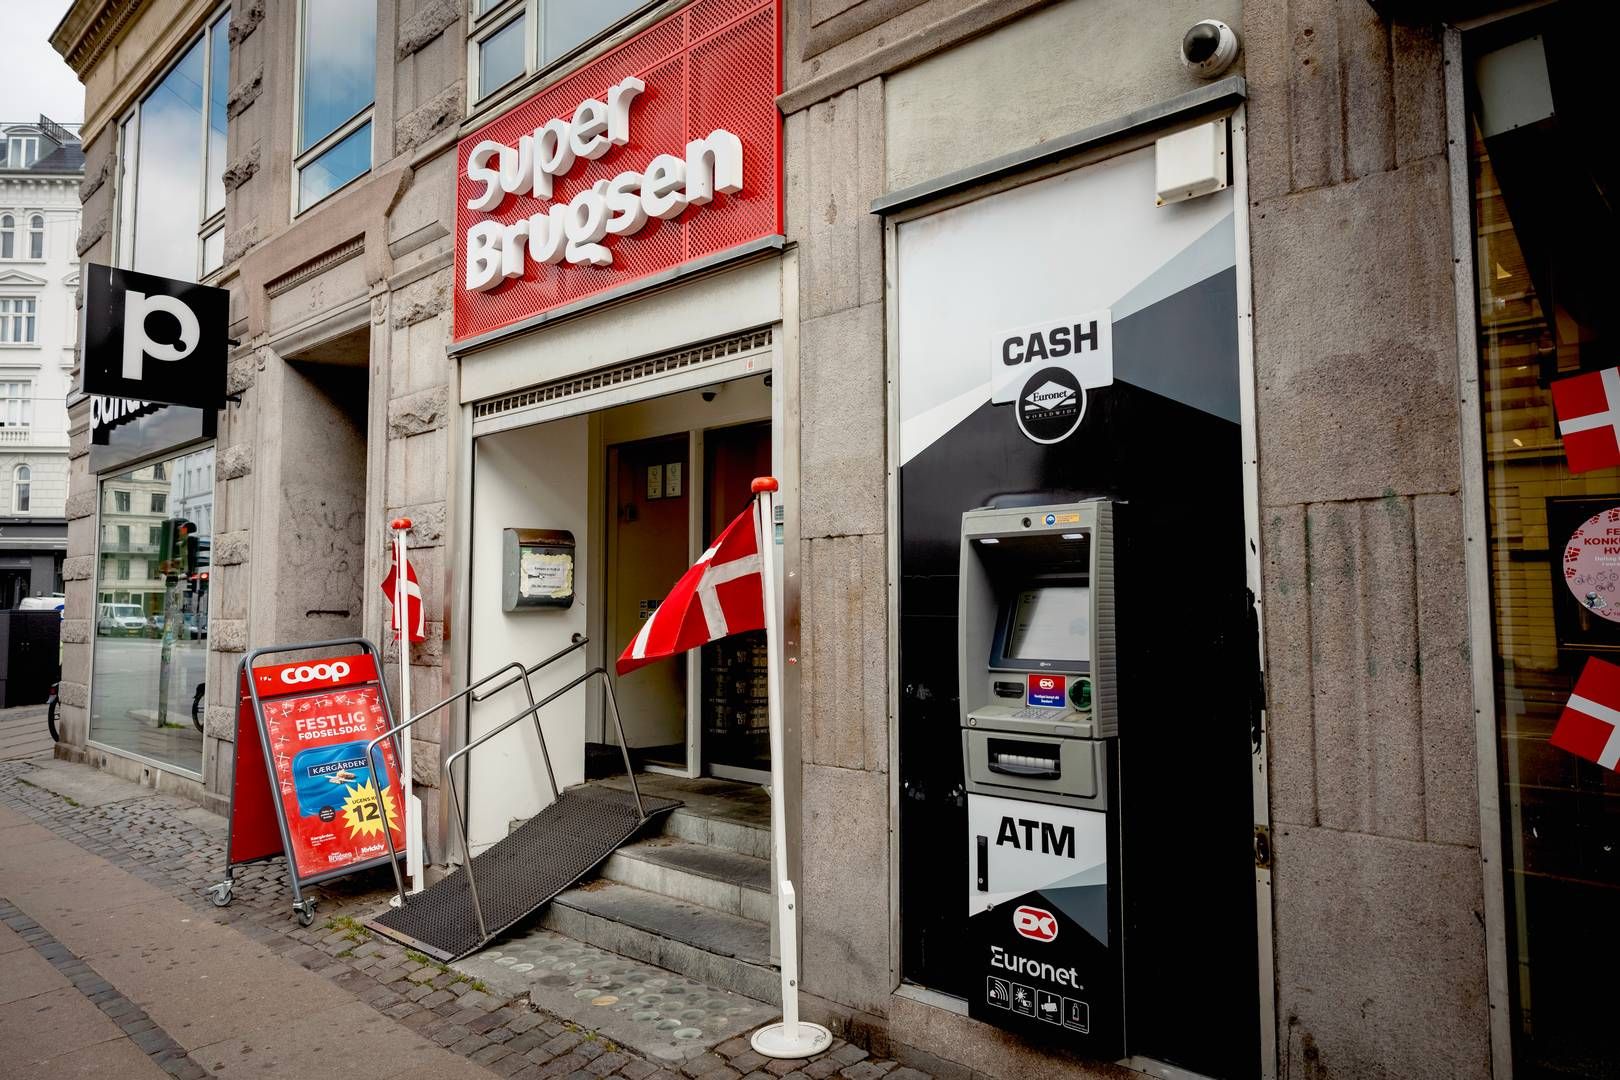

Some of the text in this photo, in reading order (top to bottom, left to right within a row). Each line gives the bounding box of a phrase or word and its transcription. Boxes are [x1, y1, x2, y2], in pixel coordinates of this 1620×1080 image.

[467, 76, 646, 213] Super
[466, 129, 743, 292] Brugsen
[1002, 320, 1098, 366] CASH
[1033, 389, 1068, 403] Euronet
[1025, 408, 1077, 420] WORLDWIDE
[1584, 537, 1620, 545] KONK
[280, 661, 350, 685] coop
[295, 711, 365, 732] FESTLIG
[298, 724, 367, 741] FØDSELSDAG
[996, 815, 1075, 859] ATM
